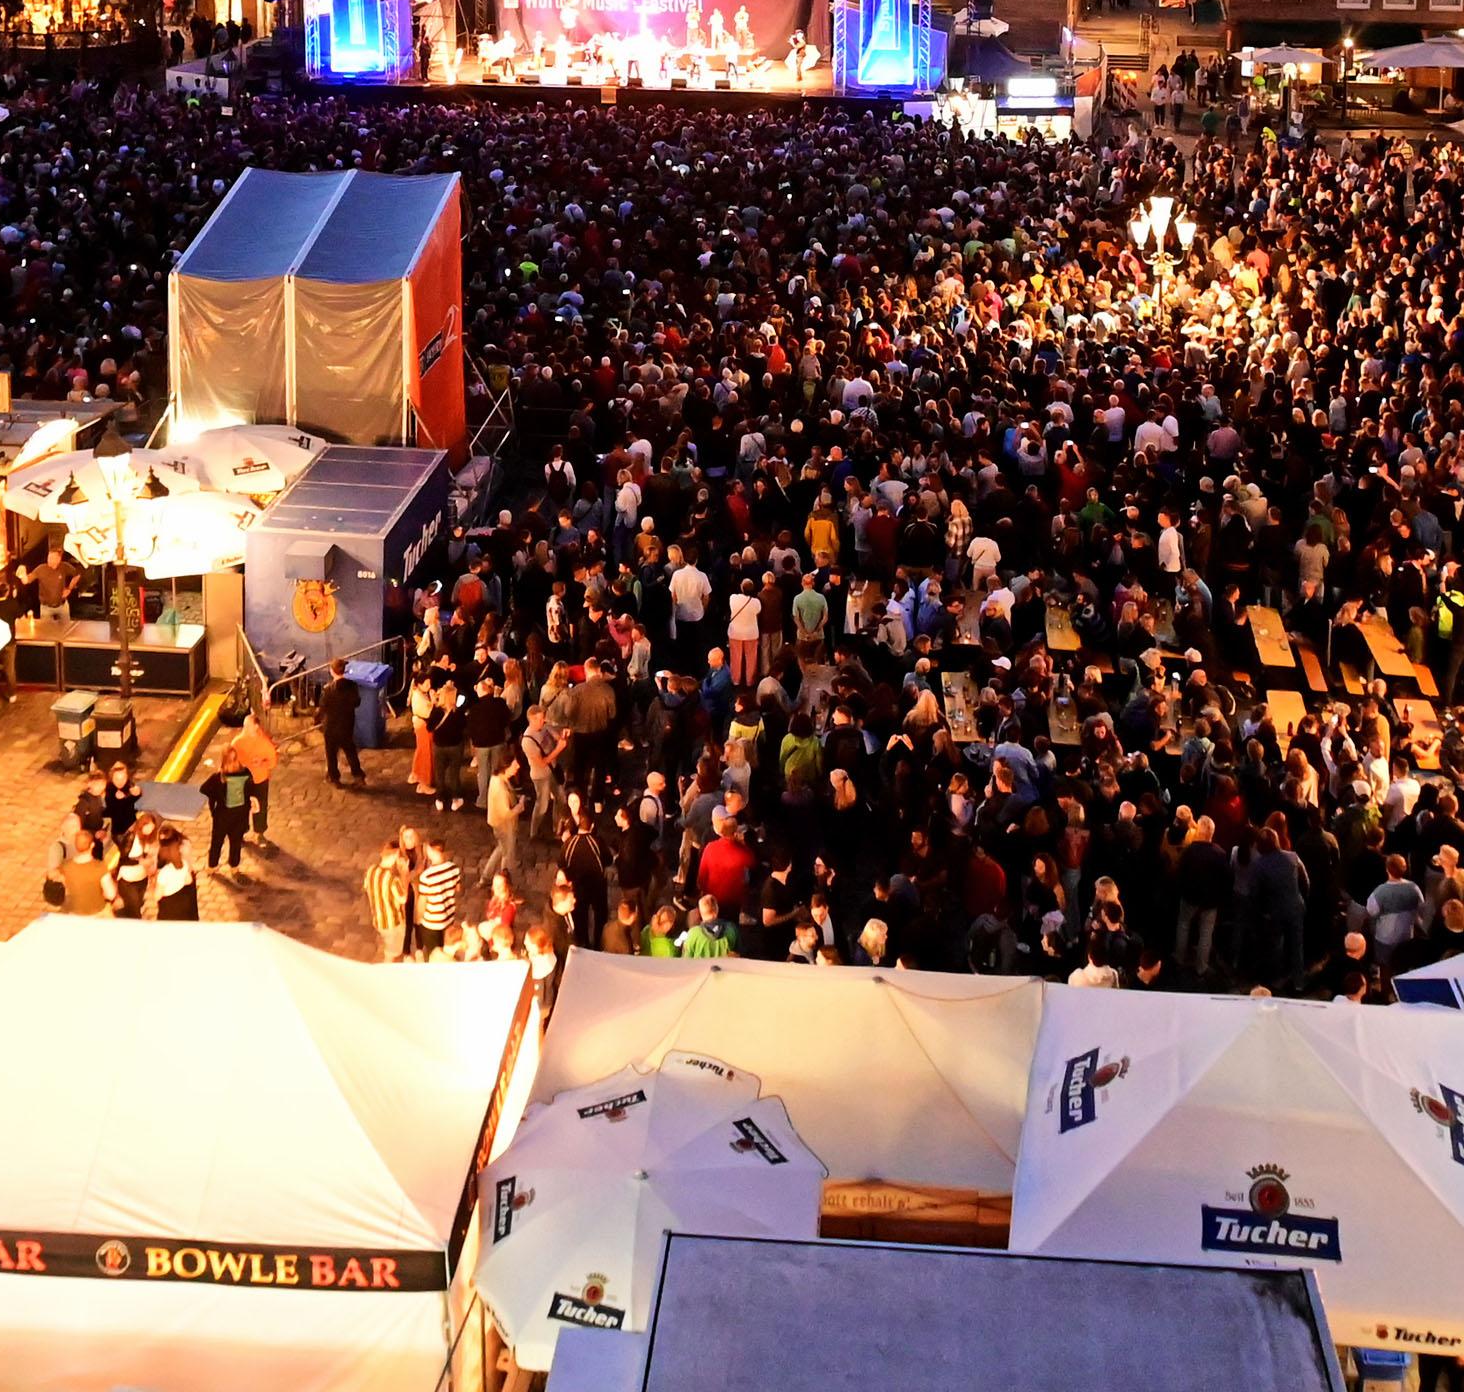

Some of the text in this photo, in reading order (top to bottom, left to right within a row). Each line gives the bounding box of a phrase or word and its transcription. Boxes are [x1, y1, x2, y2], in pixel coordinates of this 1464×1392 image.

[403, 509, 442, 584] Tucher
[685, 1057, 725, 1077] Tucher
[583, 1094, 639, 1116] Tucher
[1069, 1056, 1092, 1122] Tucher
[499, 1182, 512, 1236] Tucher
[1216, 1215, 1329, 1250] Tucher
[146, 1247, 300, 1286] BOWLE
[310, 1254, 400, 1288] BAR
[556, 1298, 619, 1329] Tucher
[1394, 1327, 1462, 1347] Tucher
